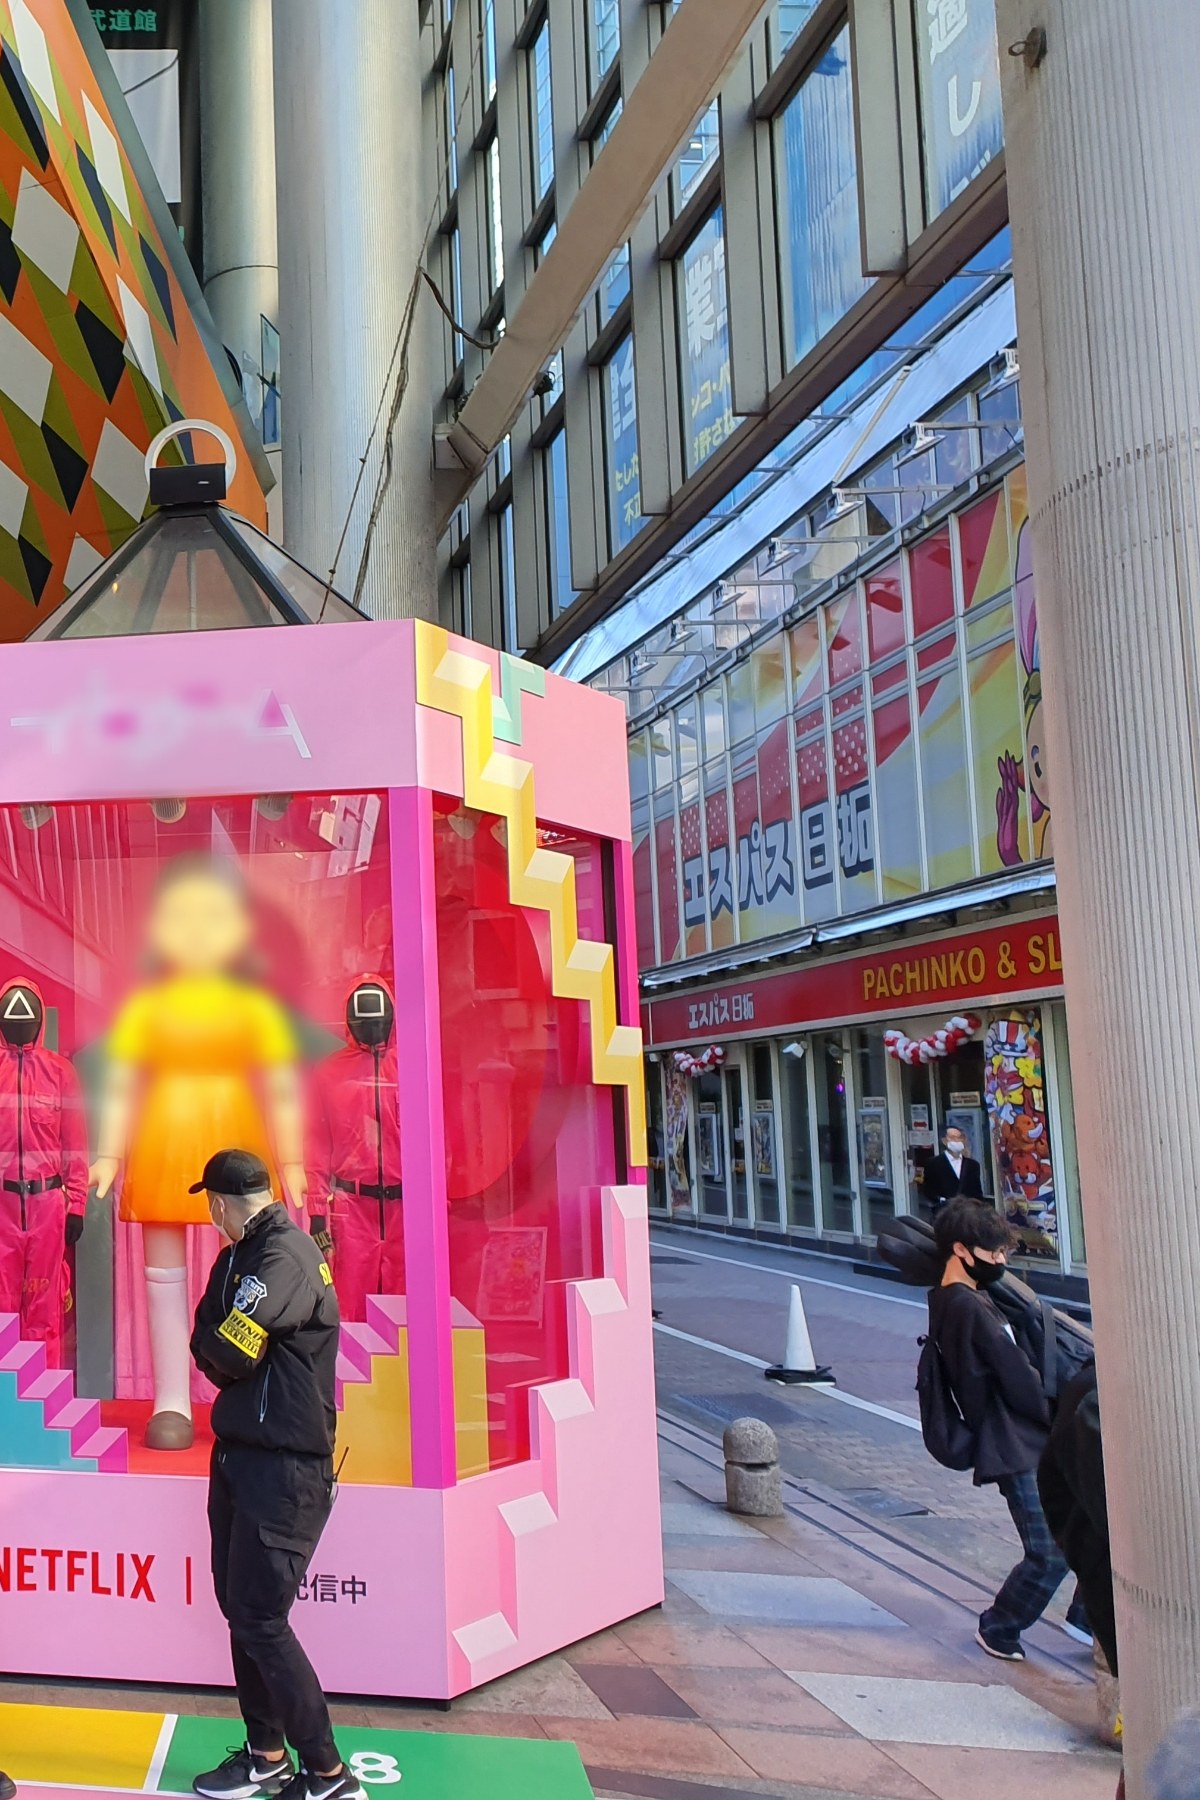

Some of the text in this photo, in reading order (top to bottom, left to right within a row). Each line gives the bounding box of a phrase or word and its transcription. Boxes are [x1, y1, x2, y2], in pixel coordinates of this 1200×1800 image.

[863, 946, 986, 1000] PACHINKO
[997, 941, 1017, 979] &
[349, 1751, 402, 1784] 8
